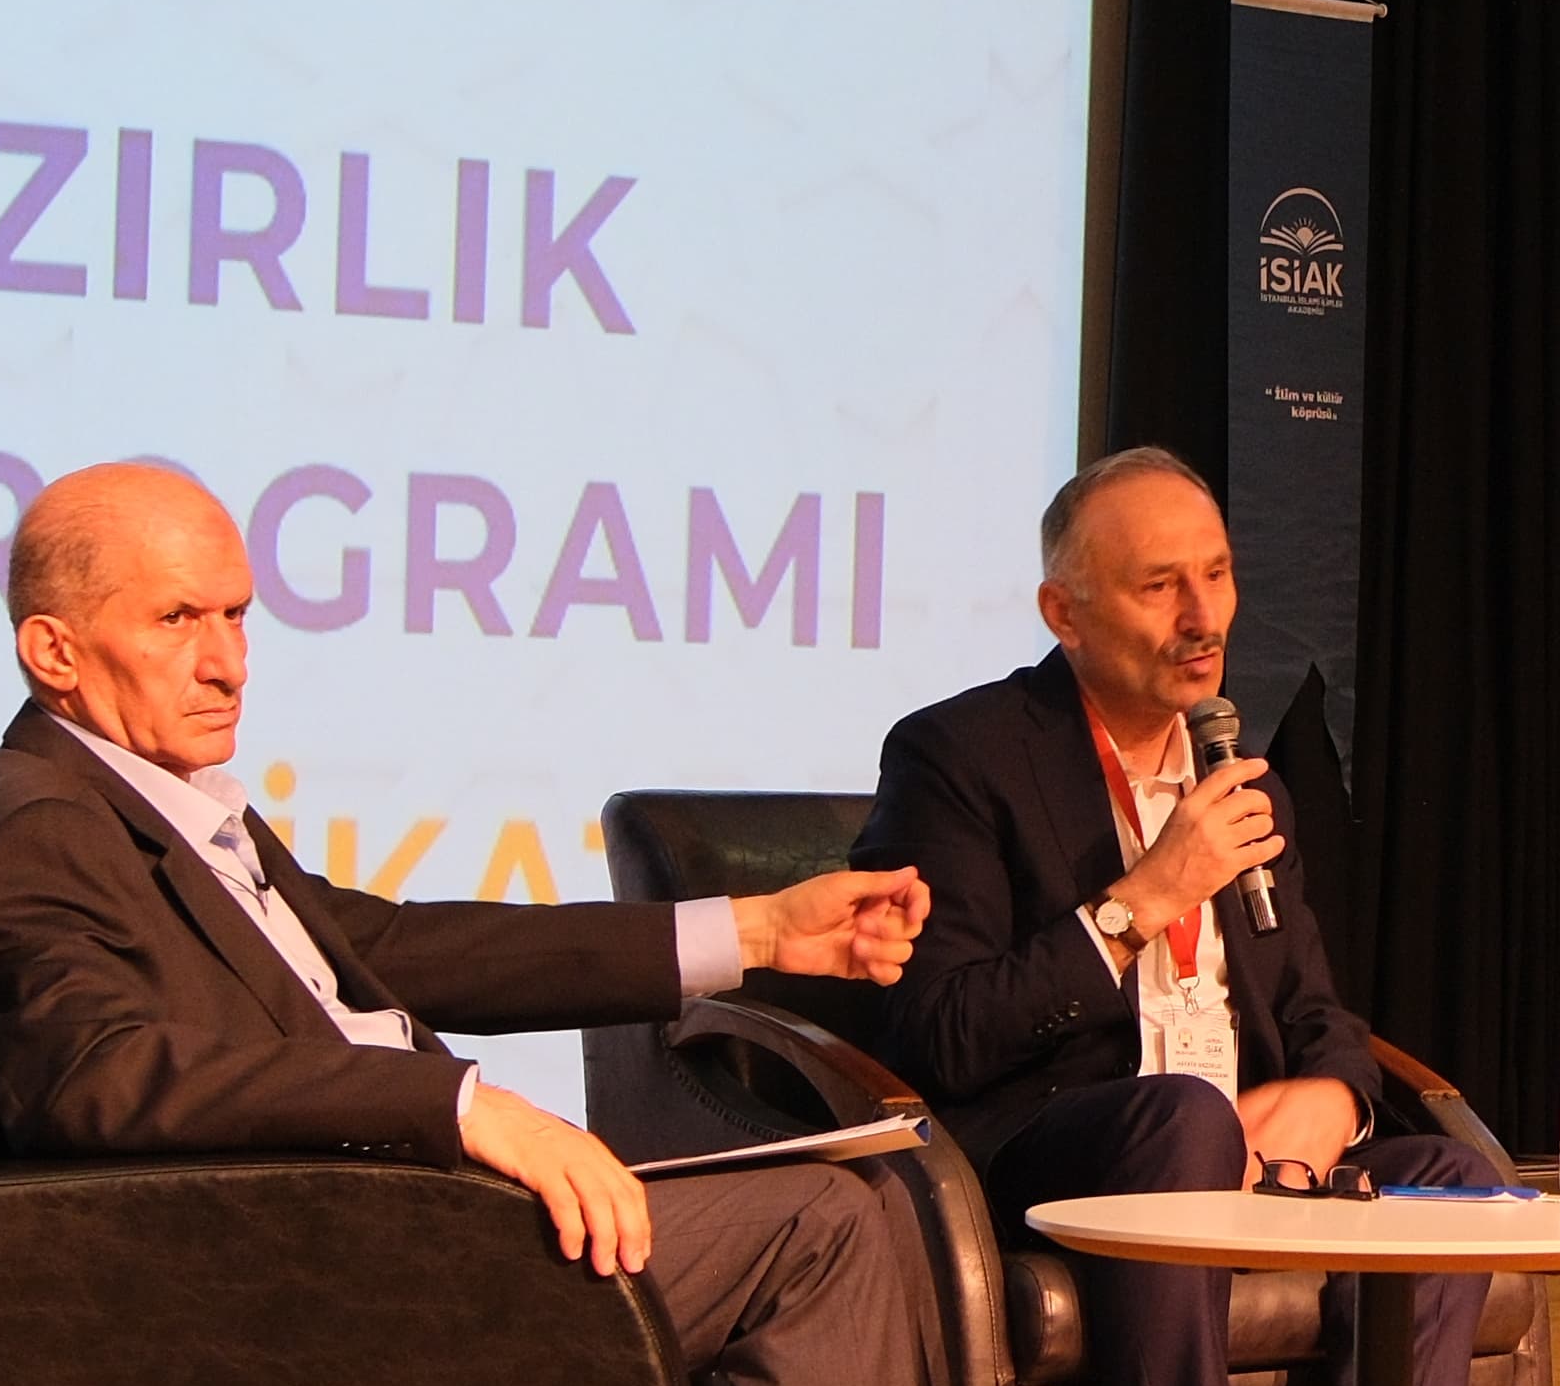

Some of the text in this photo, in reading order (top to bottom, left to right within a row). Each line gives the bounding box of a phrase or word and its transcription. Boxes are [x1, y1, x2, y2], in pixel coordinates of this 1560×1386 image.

[1260, 257, 1343, 297] İSİAK
[1302, 393, 1314, 403] ve
[1316, 391, 1343, 405] kültür
